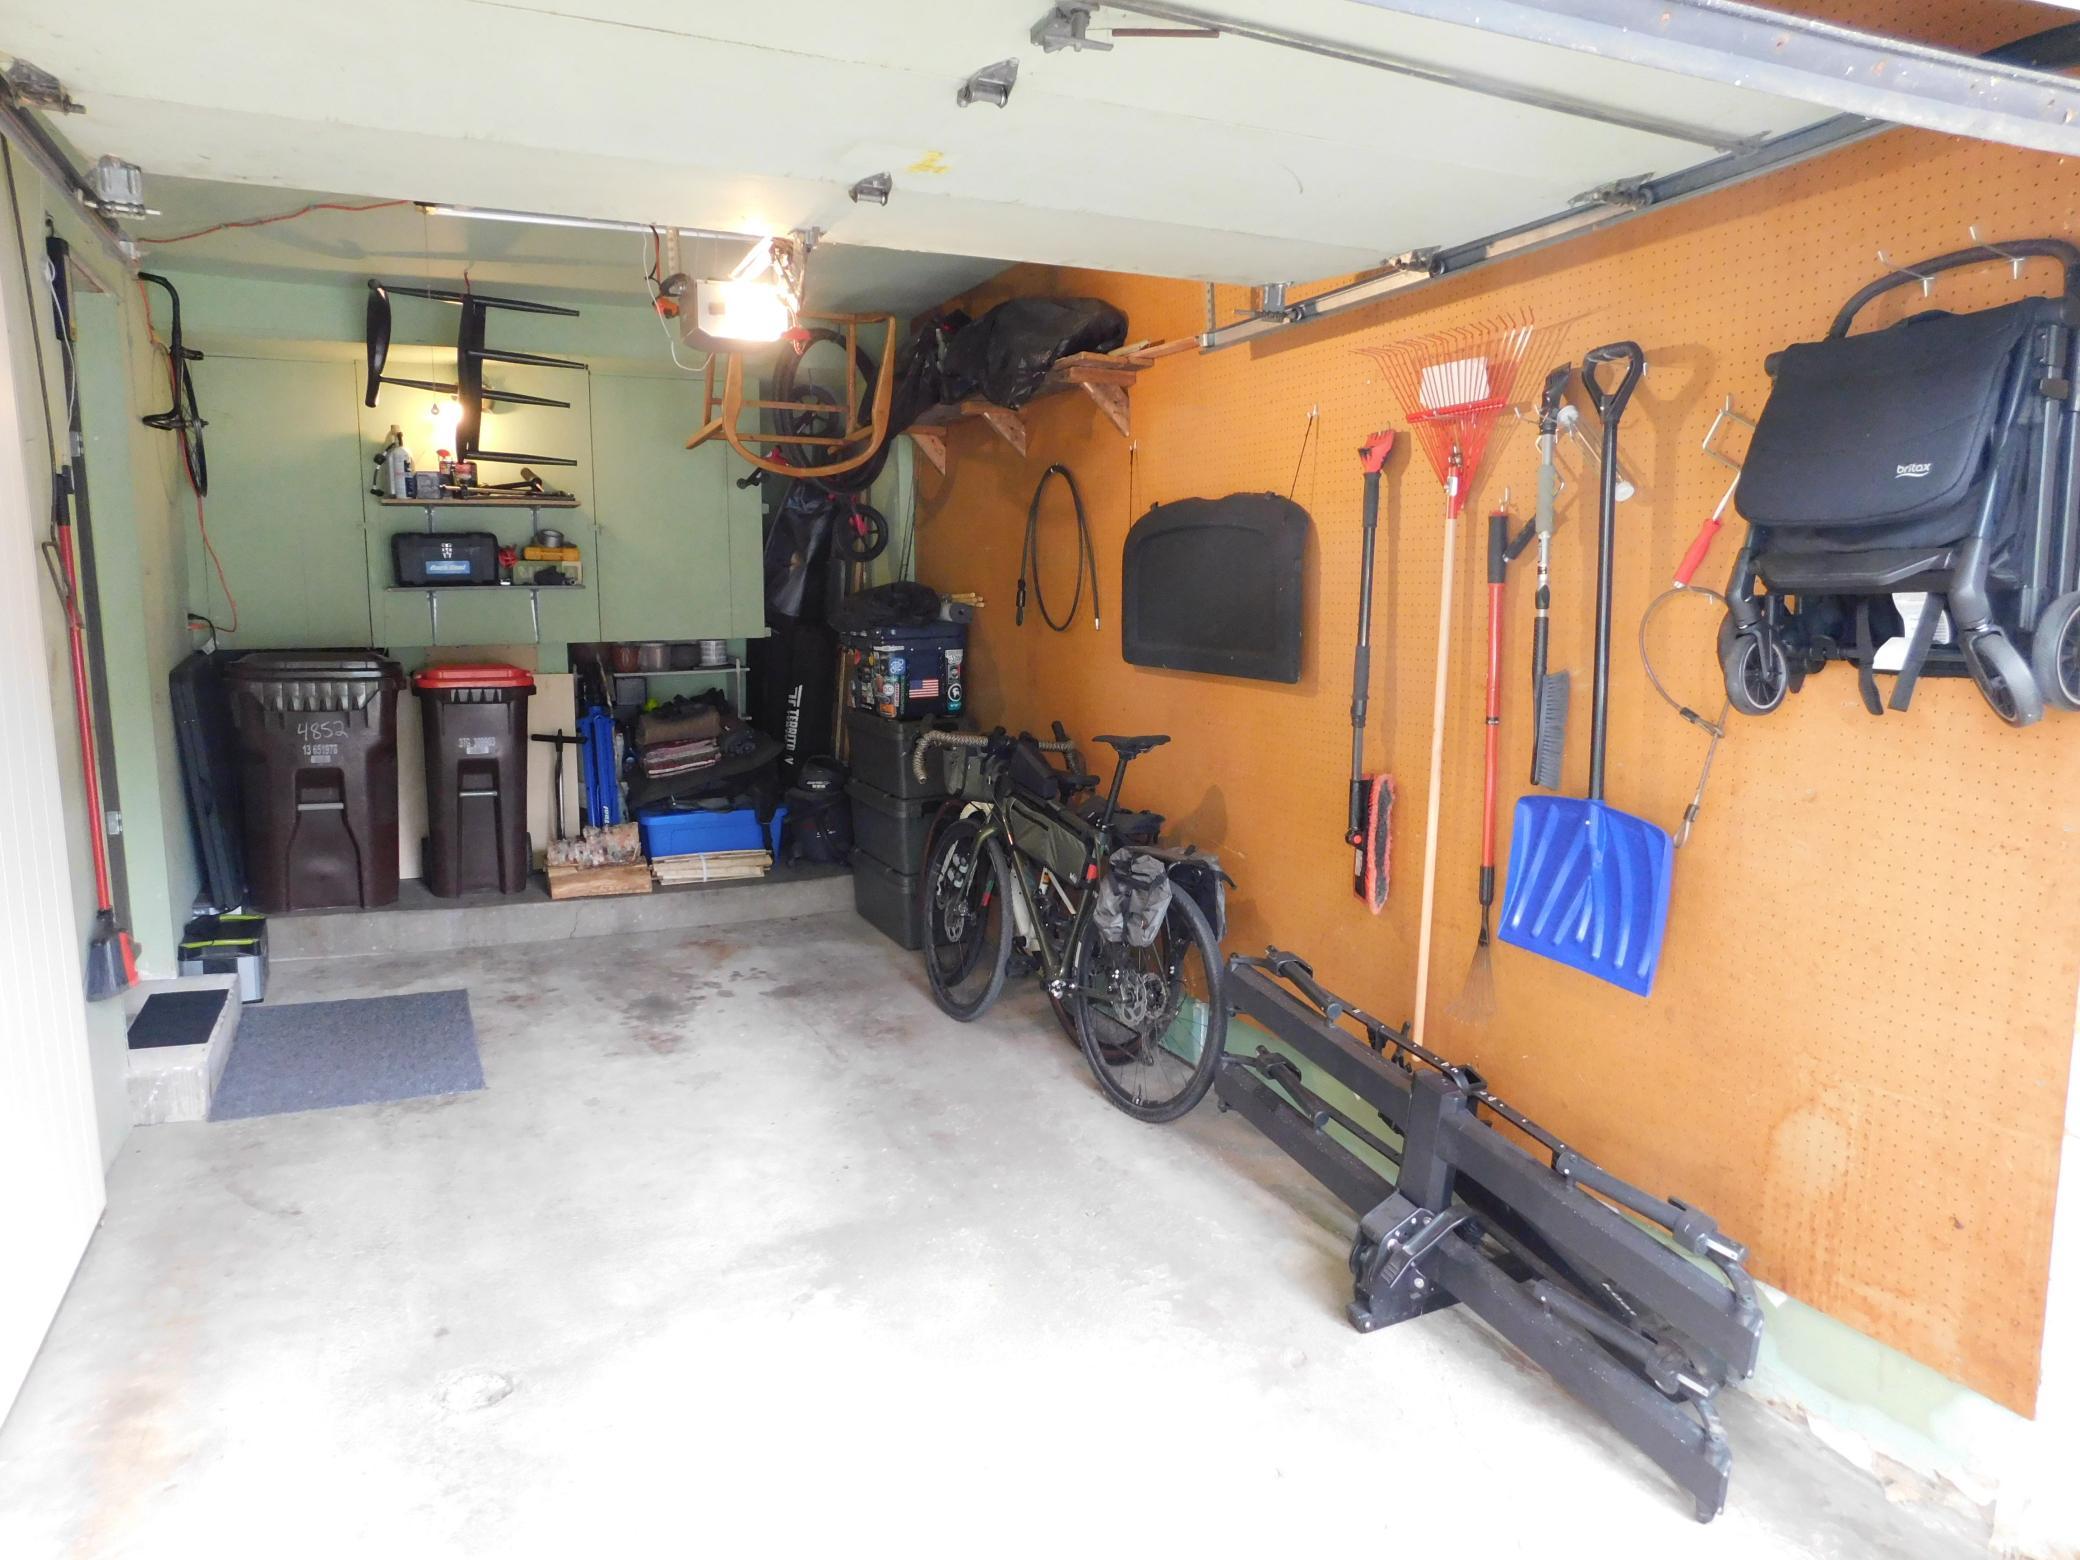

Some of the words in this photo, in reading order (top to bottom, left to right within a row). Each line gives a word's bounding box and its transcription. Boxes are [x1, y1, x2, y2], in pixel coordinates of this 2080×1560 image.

[1896, 462, 1932, 475] britax
[297, 720, 349, 742] 4852
[784, 708, 799, 766] TERRITOY
